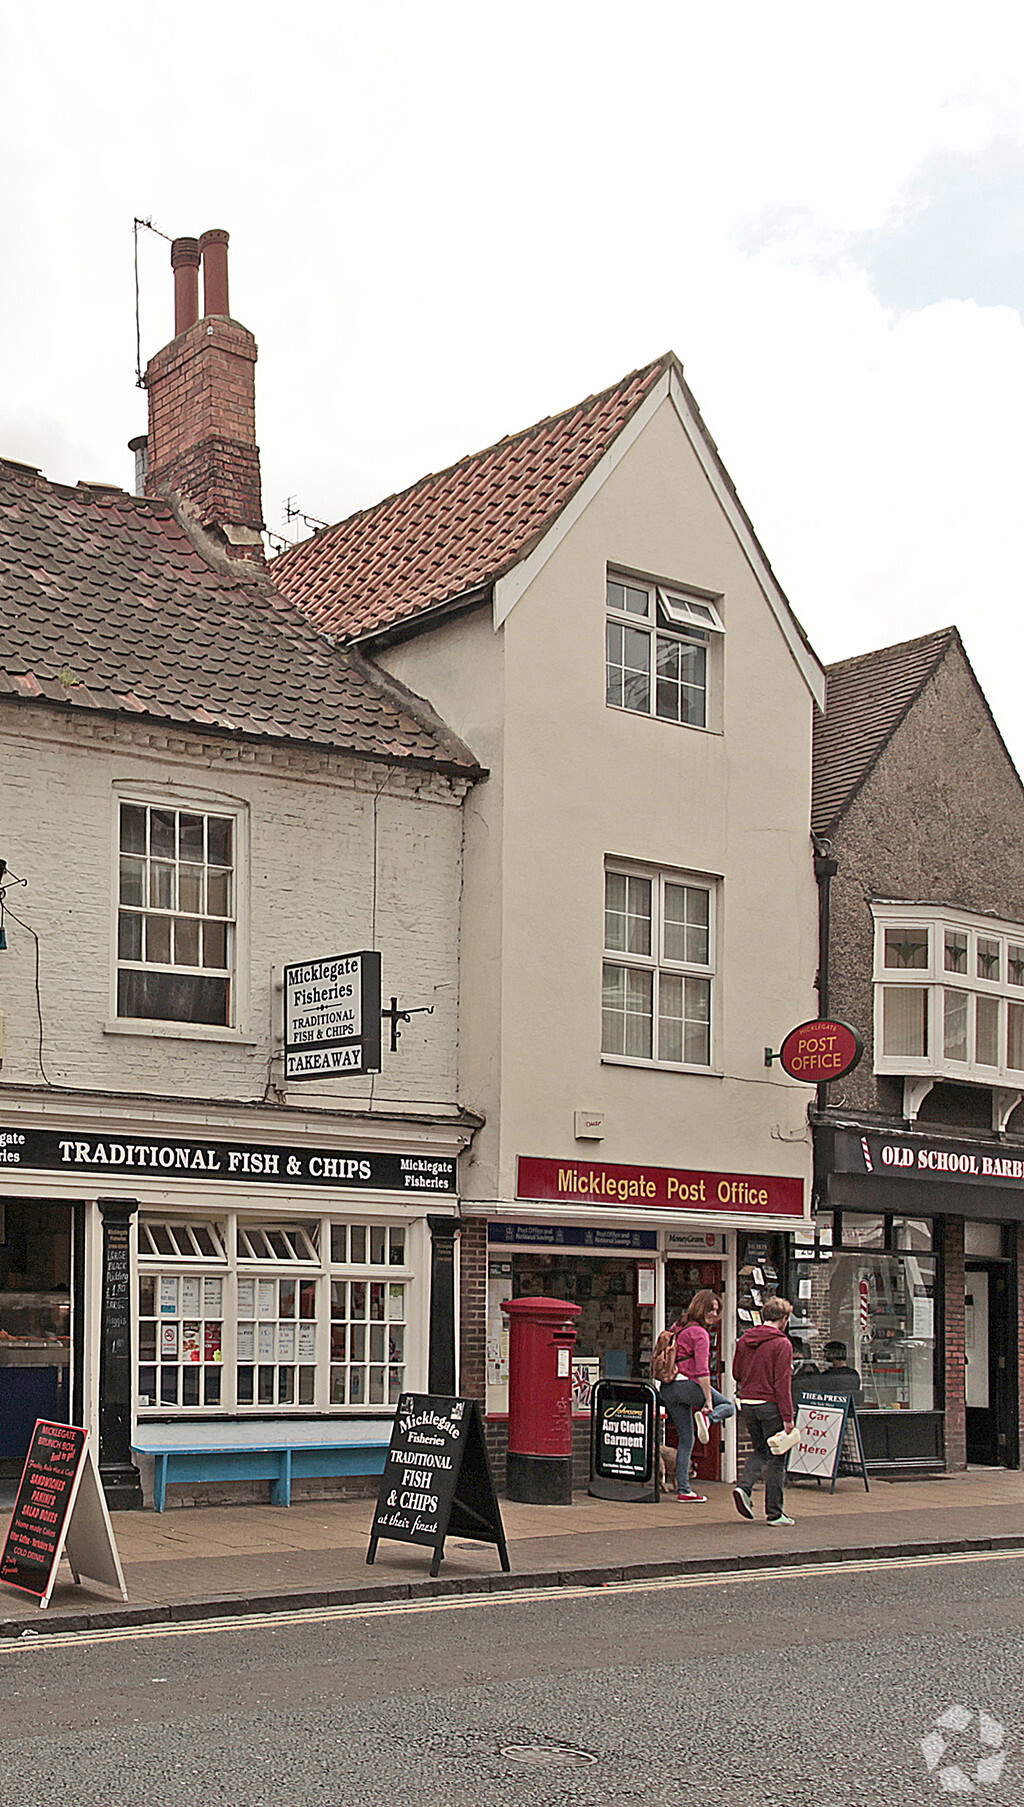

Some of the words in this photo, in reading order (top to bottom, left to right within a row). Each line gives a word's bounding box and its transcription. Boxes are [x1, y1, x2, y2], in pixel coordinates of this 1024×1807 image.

[288, 959, 358, 986] Micklegate
[294, 982, 353, 1007] Fisheries
[292, 1009, 355, 1030] TRADITIONAL
[293, 1030, 314, 1042] FISH
[316, 1029, 323, 1039] &
[326, 1023, 354, 1038] CHIPS
[799, 1024, 837, 1035] MICKLEGATE
[798, 1036, 837, 1054] POST
[288, 1050, 361, 1072] TAKEAWAY
[791, 1053, 842, 1071] OFFICE
[58, 1140, 221, 1170] TRADITIONAL
[227, 1151, 280, 1174] FISH
[286, 1155, 302, 1175] &
[308, 1157, 371, 1180] CHIPS
[400, 1158, 453, 1175] Micklegate
[881, 1145, 915, 1168] OLD
[917, 1149, 979, 1176] SCHOOL
[981, 1156, 1024, 1179] BARB
[404, 1175, 449, 1189] Fisheries
[558, 1169, 656, 1200] Micklegate
[667, 1177, 706, 1202] Post
[717, 1181, 769, 1206] Office
[517, 1226, 528, 1235] Post
[528, 1227, 543, 1235] Office
[596, 1230, 607, 1238] Post
[606, 1231, 619, 1239] Office
[668, 1233, 704, 1244] MoneyGram
[801, 1392, 818, 1400] THE
[823, 1394, 847, 1403] PRESS
[398, 1410, 460, 1439] Micklegate
[808, 1410, 830, 1421] Car
[41, 1425, 77, 1441] MICKLEGATE
[602, 1419, 619, 1433] Any
[620, 1421, 644, 1435] Cloth
[805, 1426, 827, 1438] Tax
[37, 1436, 62, 1449] BRUNCH
[407, 1431, 445, 1446] Fisheries
[604, 1432, 643, 1448] Garment
[615, 1447, 632, 1464] £5
[798, 1443, 827, 1455] Here
[390, 1449, 453, 1470] TRADITIONAL
[29, 1473, 66, 1492] SANDWICHES
[401, 1469, 433, 1489] FISH
[386, 1489, 398, 1507] &
[399, 1491, 439, 1514] CHIPS
[21, 1504, 40, 1519] SALAD
[39, 1509, 59, 1524] BOXES
[377, 1513, 388, 1525] at
[388, 1511, 410, 1529] their
[410, 1514, 438, 1535] finest
